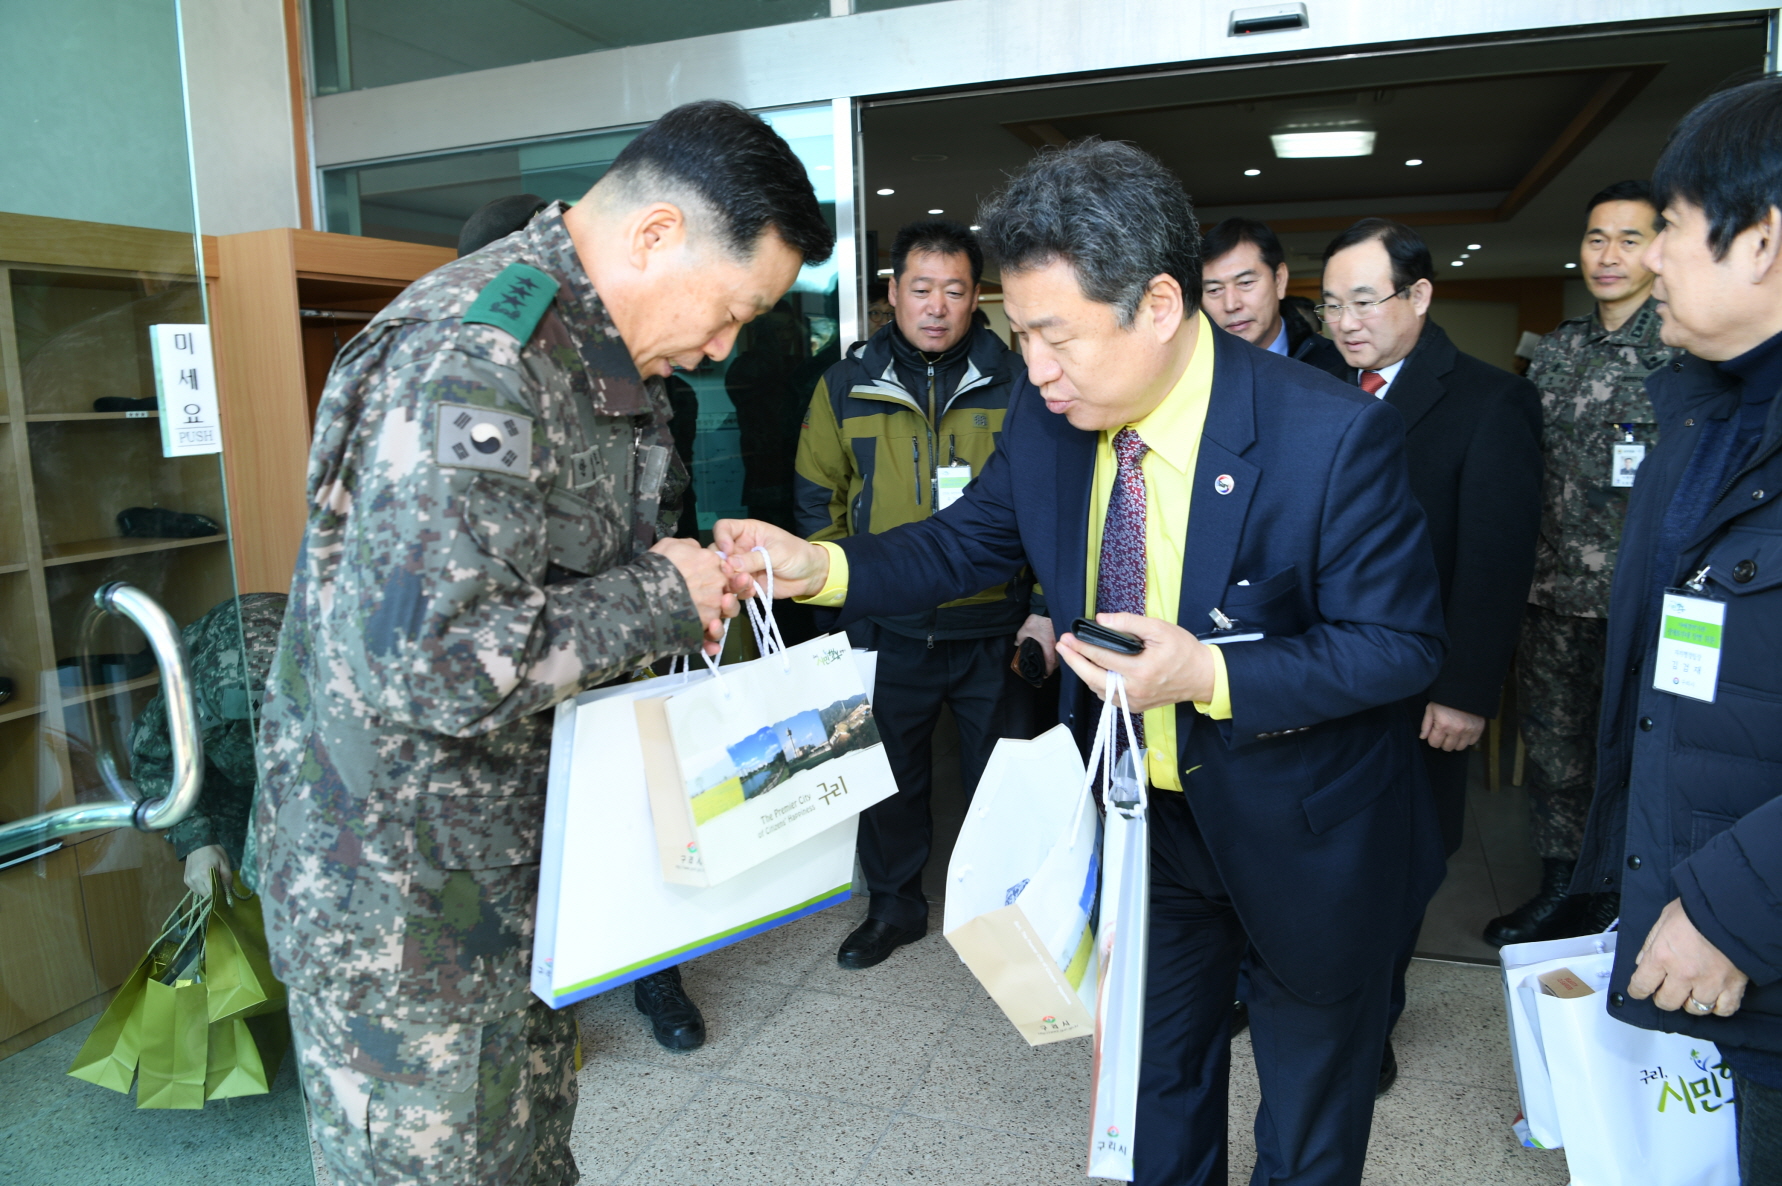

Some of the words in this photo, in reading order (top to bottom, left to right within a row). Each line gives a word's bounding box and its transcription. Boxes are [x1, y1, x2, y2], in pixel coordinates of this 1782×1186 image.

[179, 430, 214, 444] PUSH
[816, 775, 848, 806] 구리
[761, 814, 774, 825] The
[774, 800, 798, 818] Premier
[798, 793, 811, 805] City
[788, 804, 816, 823] Happiness
[1097, 1141, 1127, 1156] 구리시
